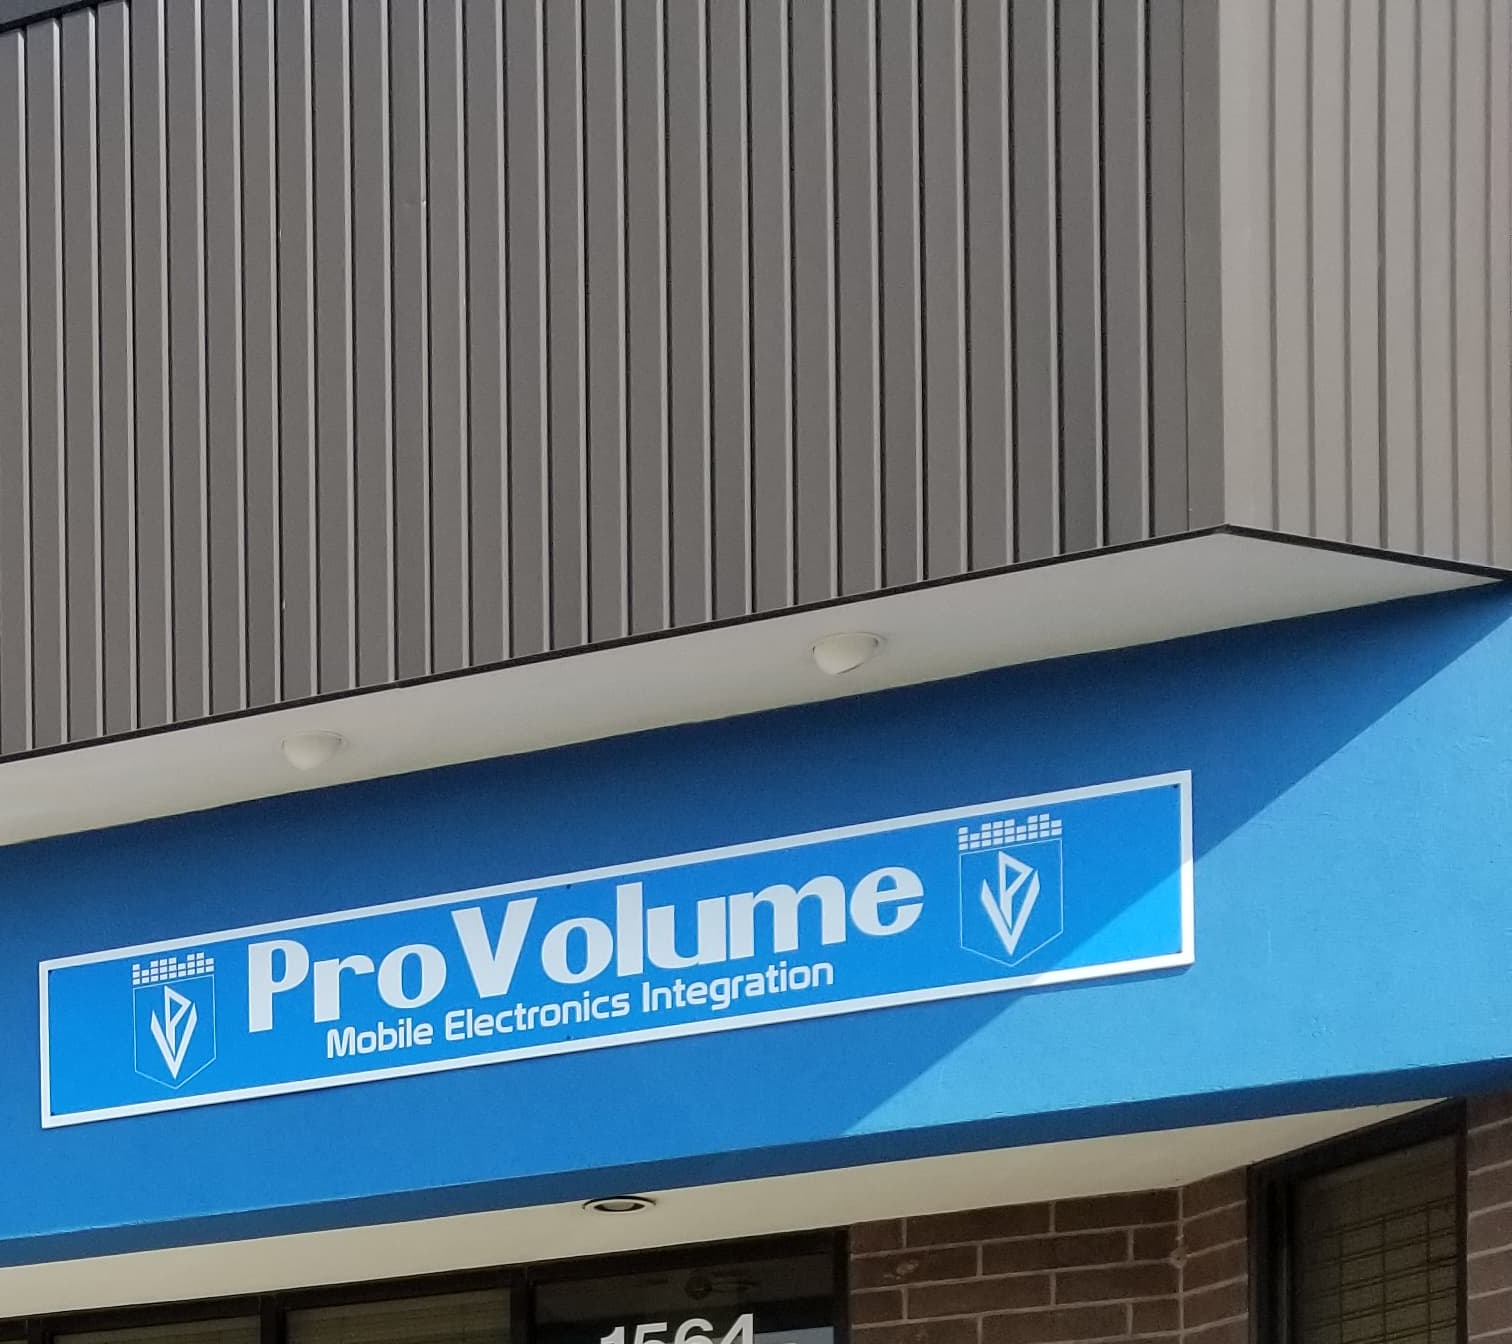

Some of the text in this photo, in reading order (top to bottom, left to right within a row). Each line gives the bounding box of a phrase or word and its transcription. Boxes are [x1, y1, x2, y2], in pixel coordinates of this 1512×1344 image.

[248, 866, 925, 1033] ProVolume
[327, 960, 834, 1059] Mobile Electronics Integration
